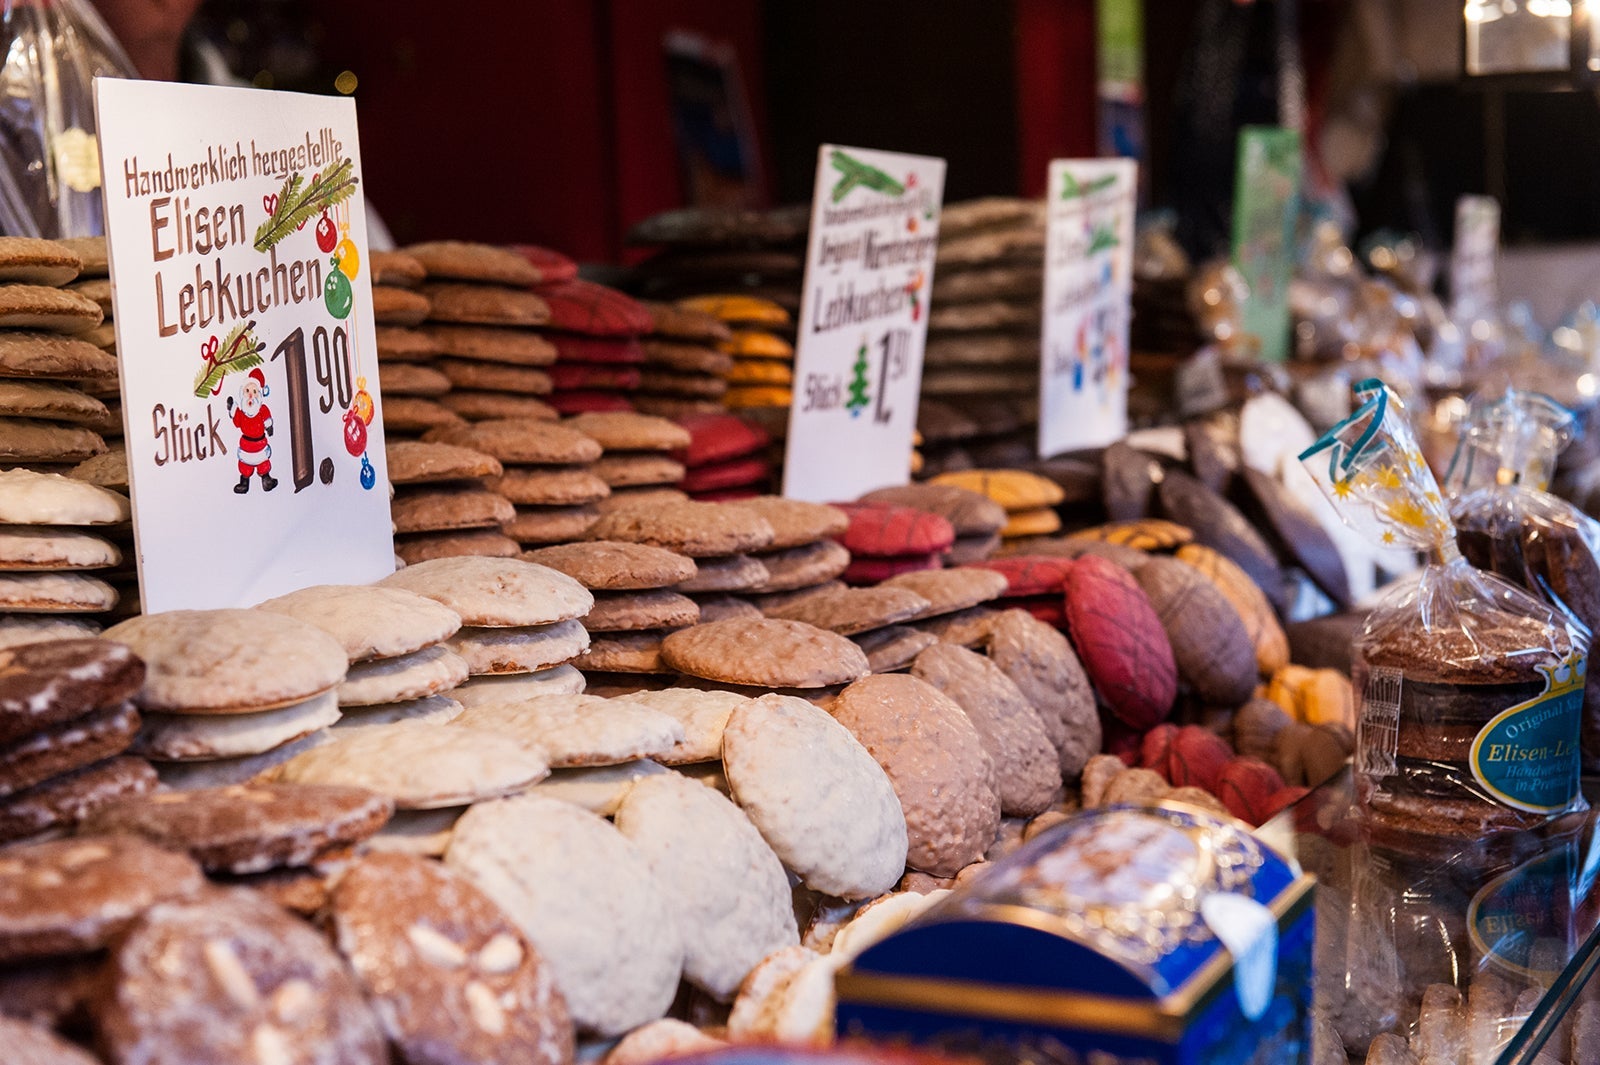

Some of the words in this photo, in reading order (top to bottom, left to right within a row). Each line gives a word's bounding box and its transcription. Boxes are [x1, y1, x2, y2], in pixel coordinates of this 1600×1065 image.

[124, 141, 248, 199] Handwerklich
[250, 127, 343, 180] hergestellte
[150, 196, 247, 262] Elisen
[154, 243, 322, 338] Lebkuchen
[152, 402, 228, 467] Stück
[1505, 703, 1563, 739] Original
